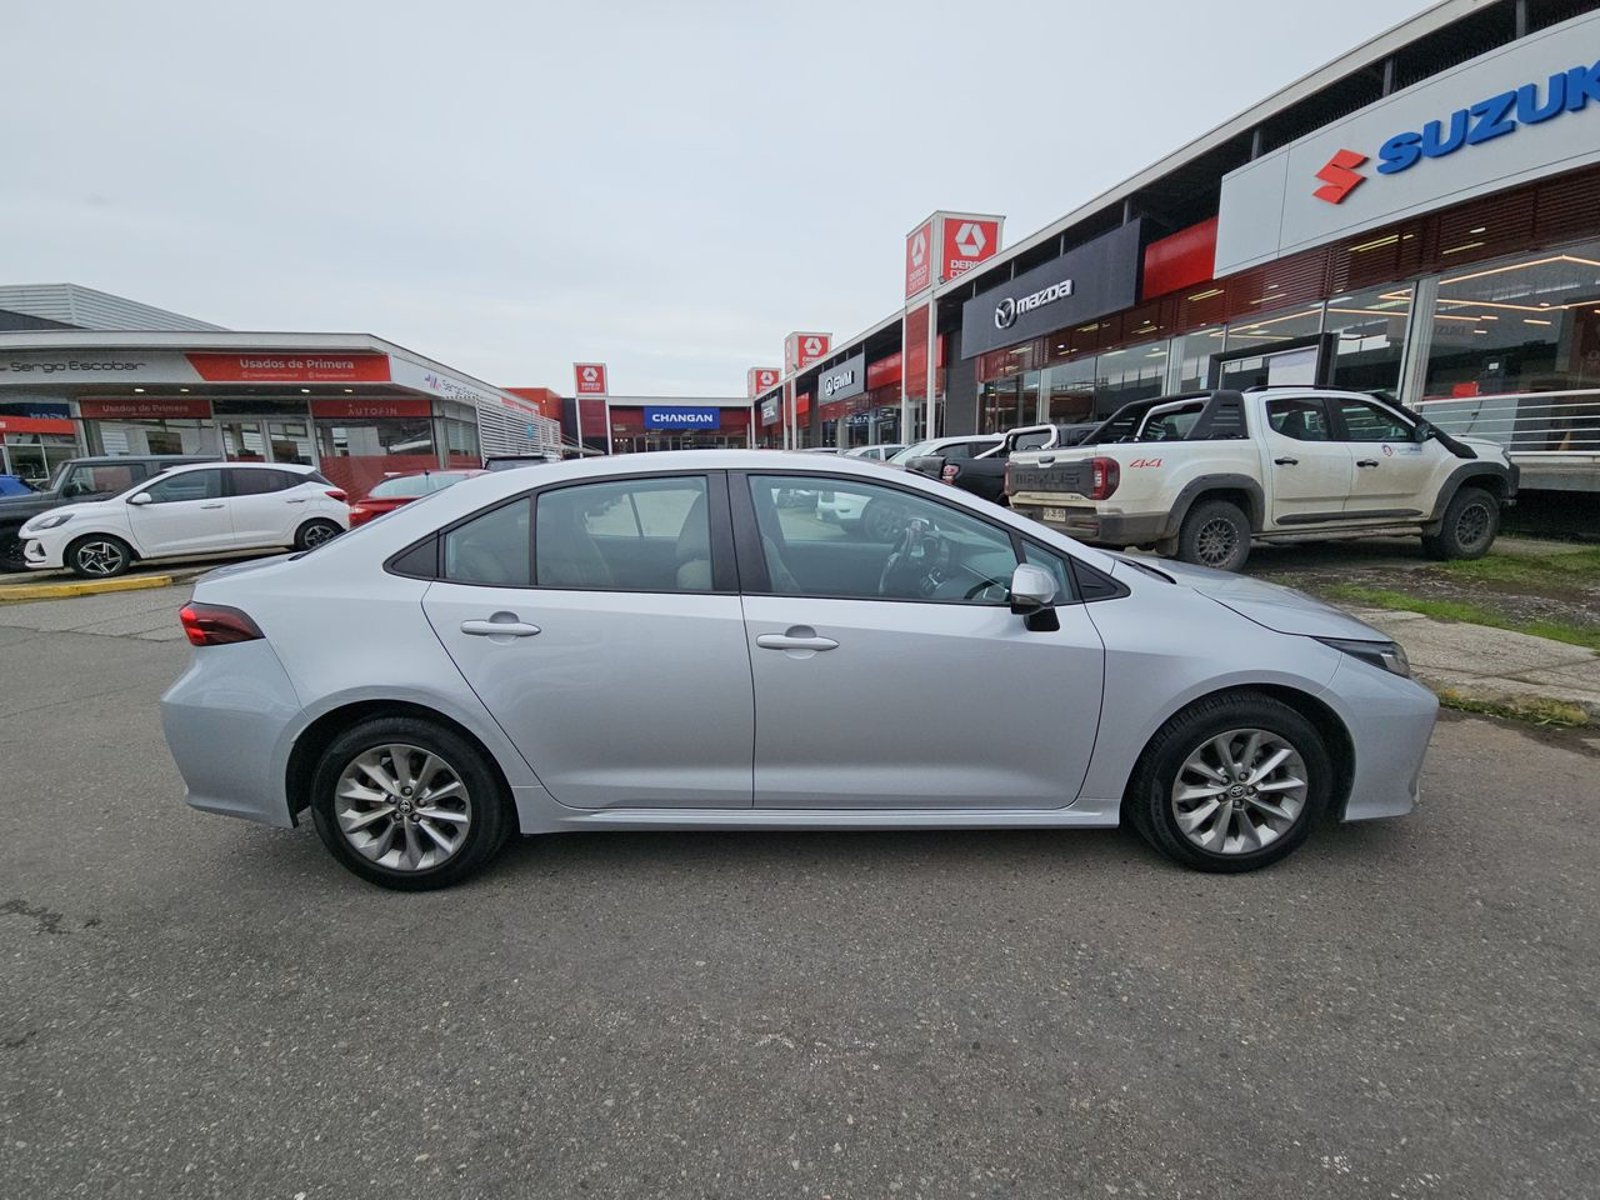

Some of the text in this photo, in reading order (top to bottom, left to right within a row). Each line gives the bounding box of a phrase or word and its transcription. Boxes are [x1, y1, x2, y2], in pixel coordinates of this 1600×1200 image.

[68, 360, 146, 371] Escobar
[240, 359, 354, 369] Usados de Primera
[652, 413, 713, 422] CHANGAN
